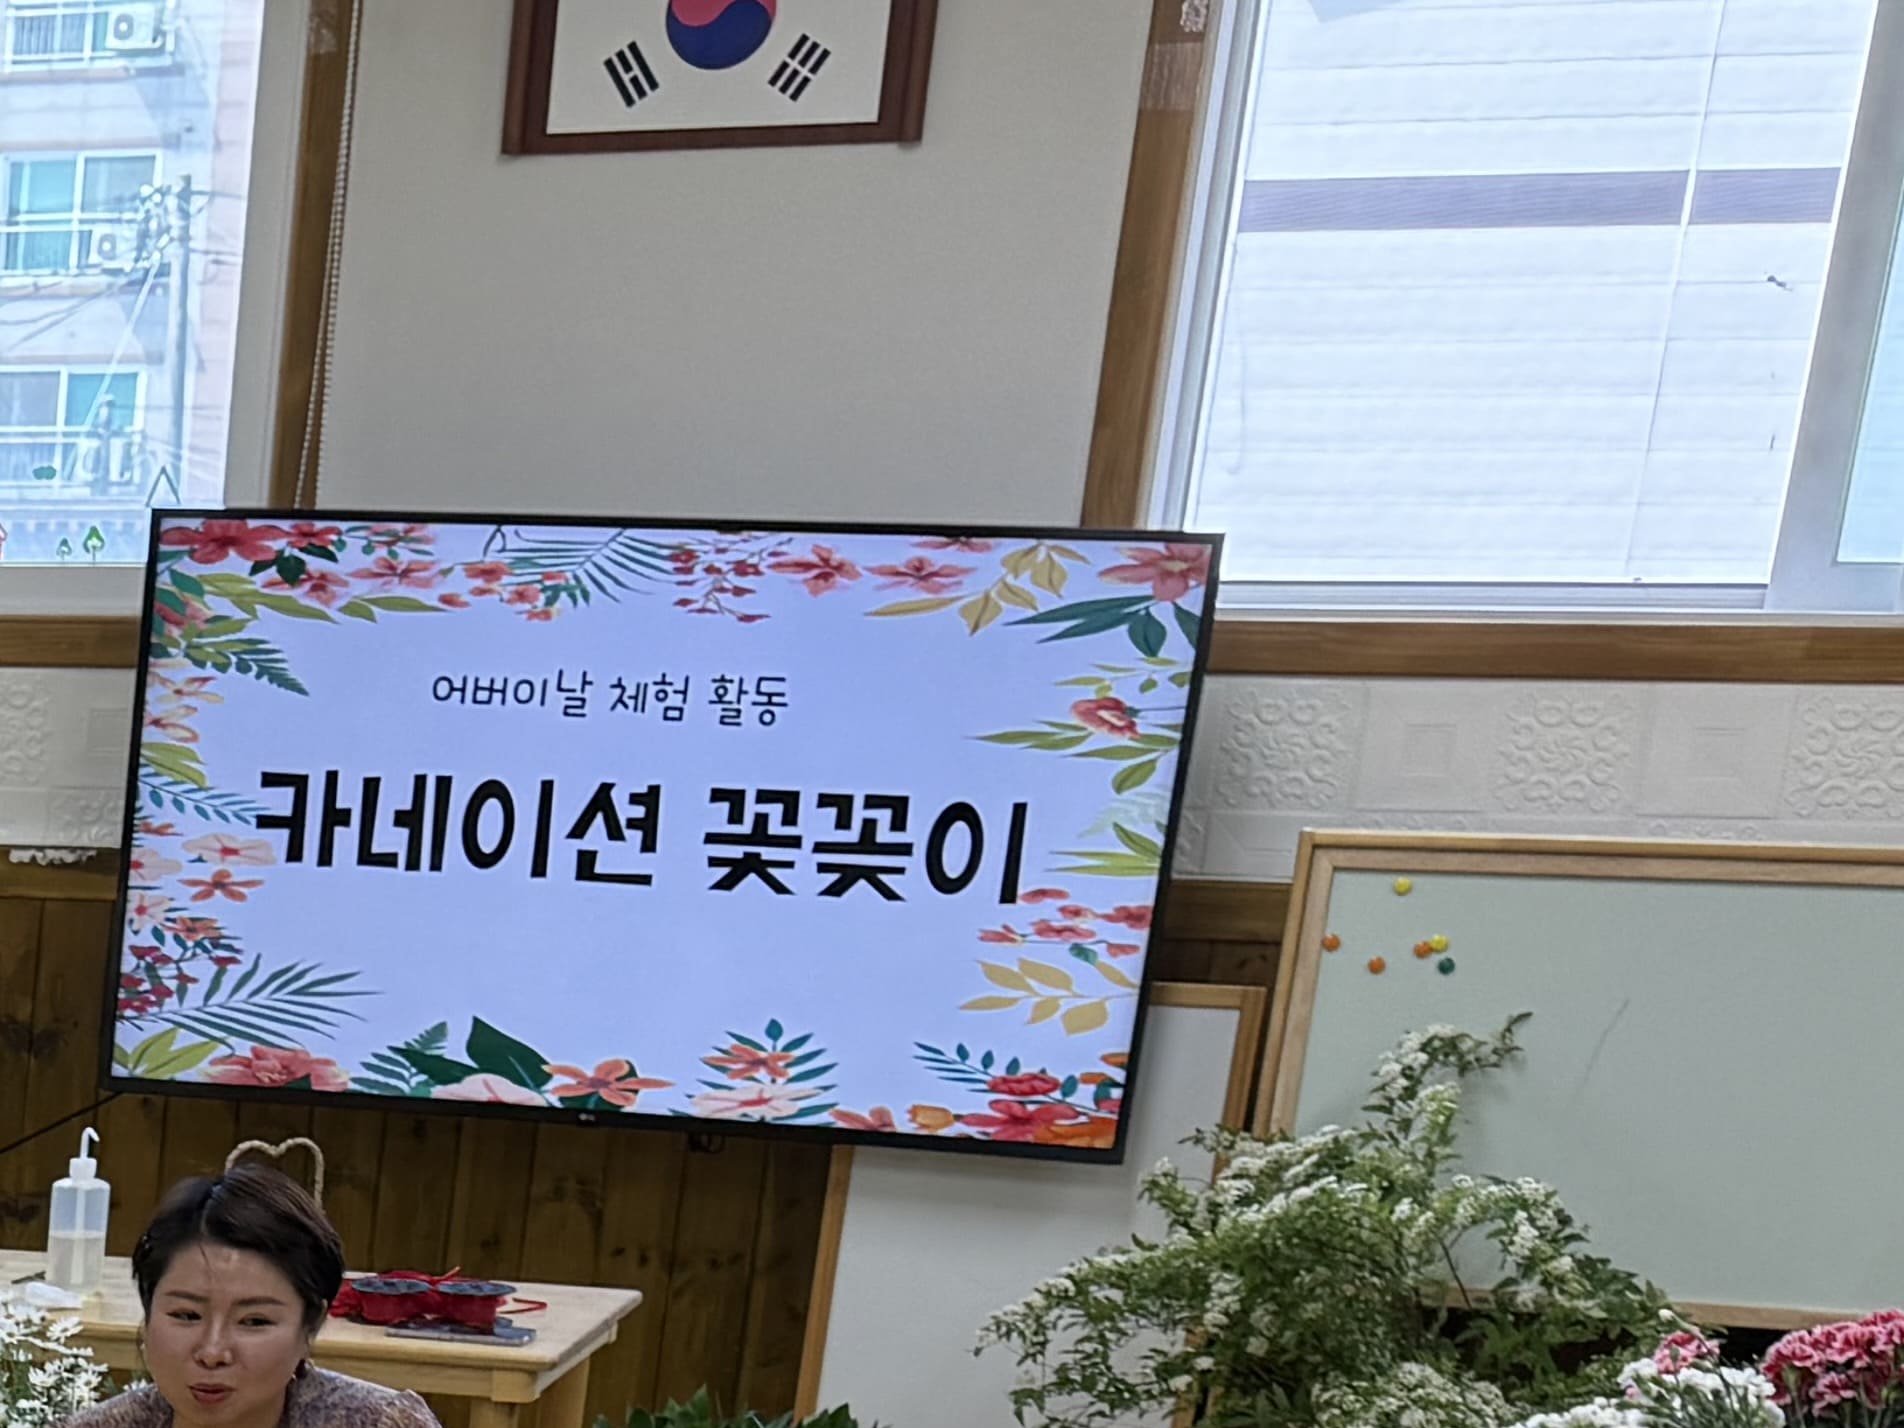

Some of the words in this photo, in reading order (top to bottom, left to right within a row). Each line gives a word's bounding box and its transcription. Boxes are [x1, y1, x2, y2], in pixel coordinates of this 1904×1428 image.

[431, 668, 594, 719] 어버이날
[608, 671, 691, 723] 체험
[707, 673, 790, 728] 활동
[255, 768, 662, 887] 카네이션
[702, 786, 1029, 905] 꽃꽂이
